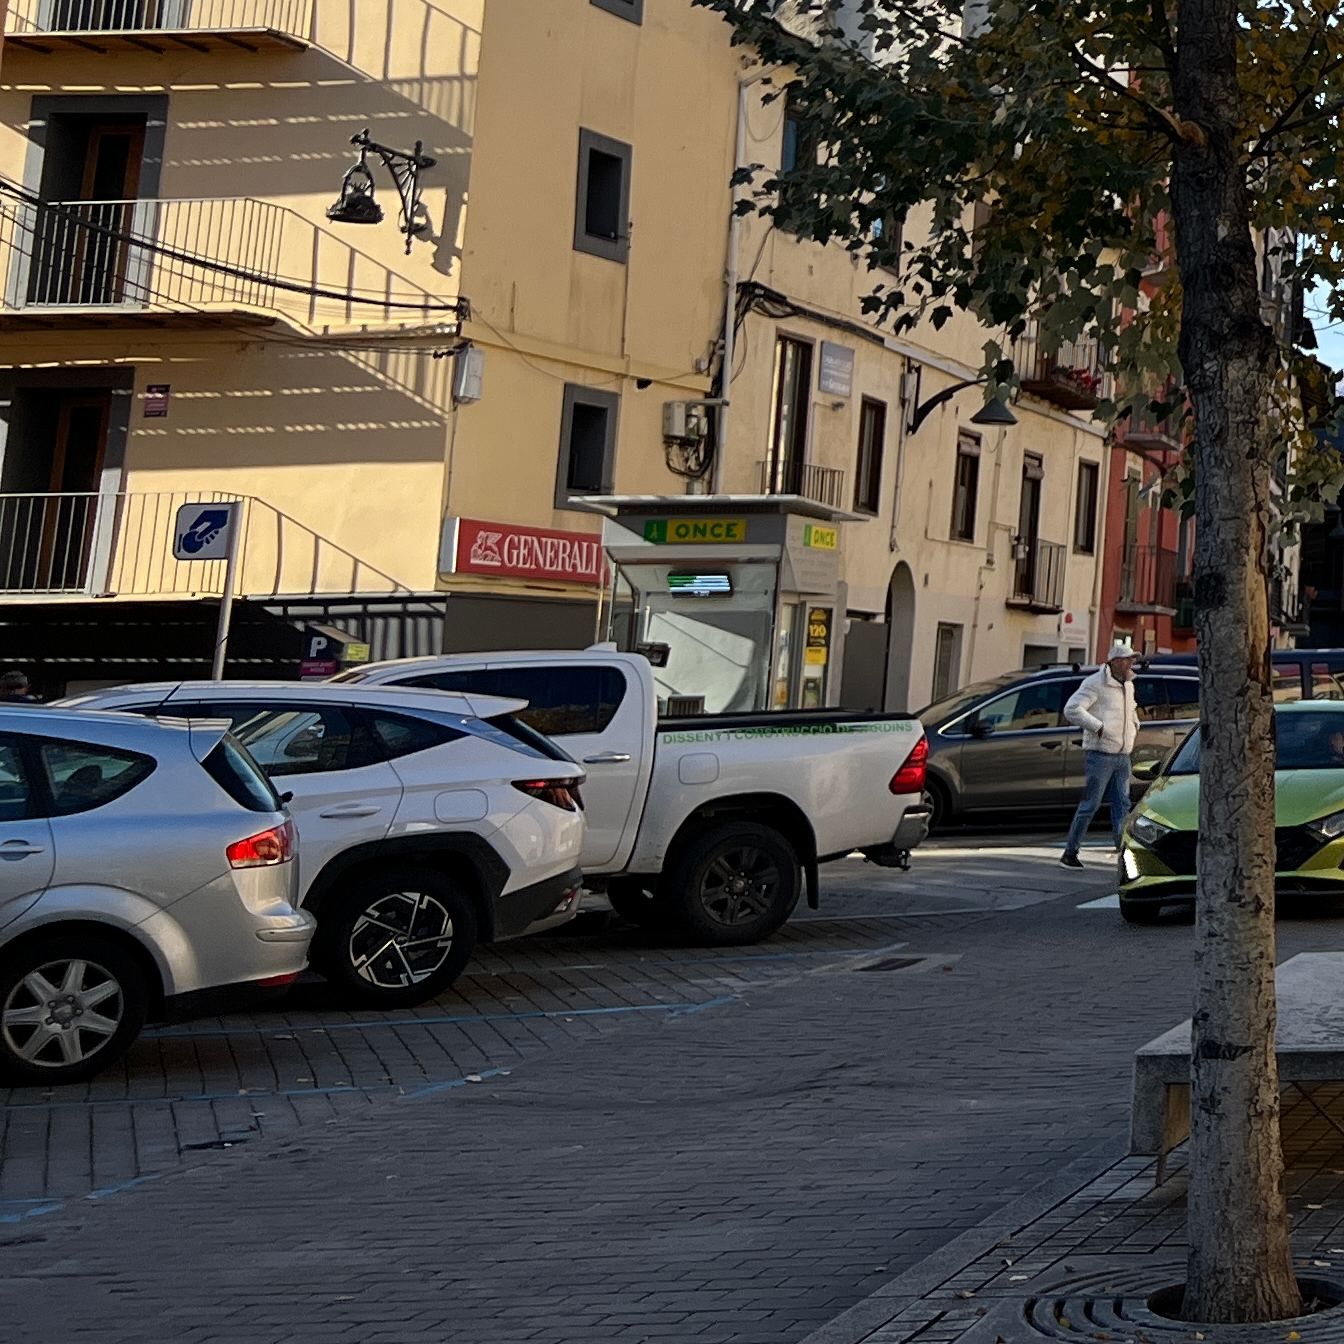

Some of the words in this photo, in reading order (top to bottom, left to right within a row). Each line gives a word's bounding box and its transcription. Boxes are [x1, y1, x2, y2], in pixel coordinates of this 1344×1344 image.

[675, 522, 739, 539] ONCE
[813, 529, 836, 548] ONCE
[503, 534, 599, 575] GENERALI
[309, 636, 328, 658] P
[662, 731, 722, 745] DISSENY
